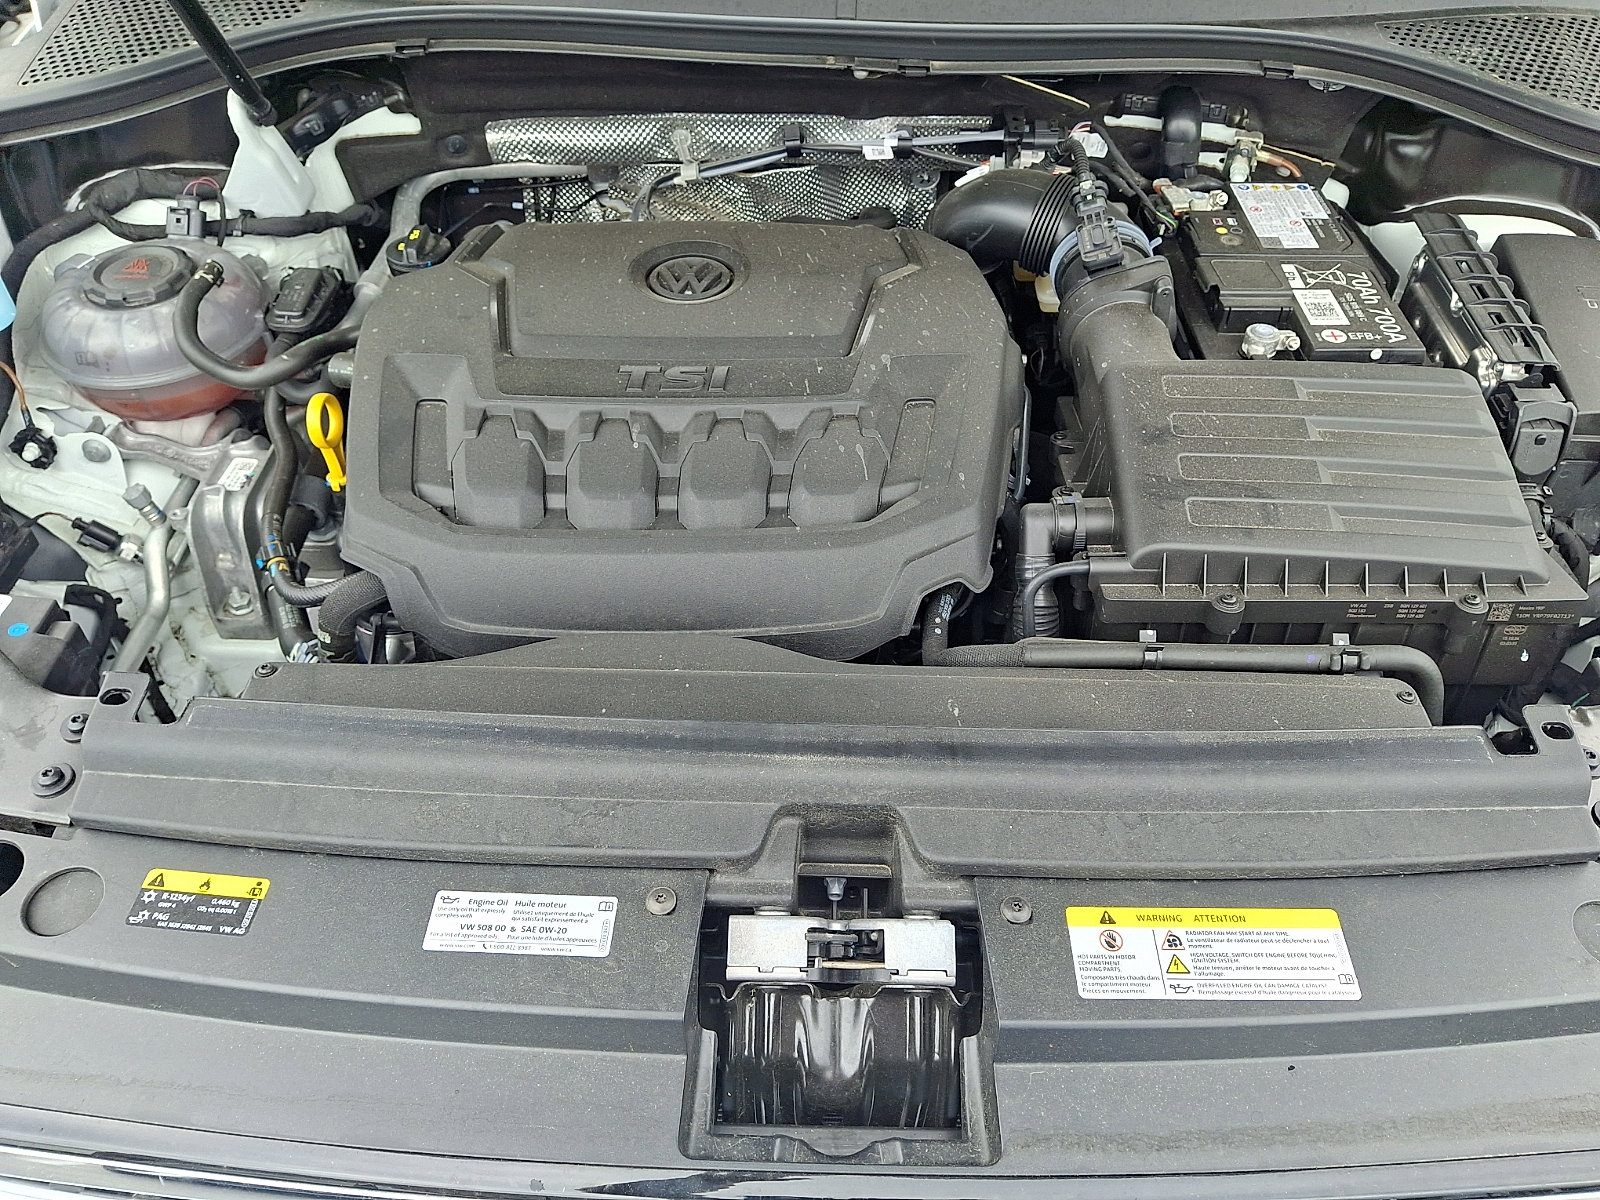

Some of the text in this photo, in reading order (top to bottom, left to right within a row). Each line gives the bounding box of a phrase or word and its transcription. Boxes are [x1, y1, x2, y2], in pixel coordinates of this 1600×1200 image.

[1284, 271, 1295, 281] Pb
[1347, 271, 1381, 304] 70Ah
[1366, 307, 1408, 343] 700A
[1347, 332, 1382, 340] EFB+
[618, 365, 731, 392] TSI
[161, 892, 196, 904] R-1234yf
[231, 899, 240, 908] kg
[468, 899, 508, 908] Engine Oil
[151, 911, 170, 920] PAG
[1136, 914, 1183, 922] WARNING
[1194, 914, 1246, 923] ATTENTION
[219, 926, 234, 934] VW
[233, 927, 245, 935] AG
[495, 924, 507, 932] 00
[539, 926, 568, 934] 0W-20
